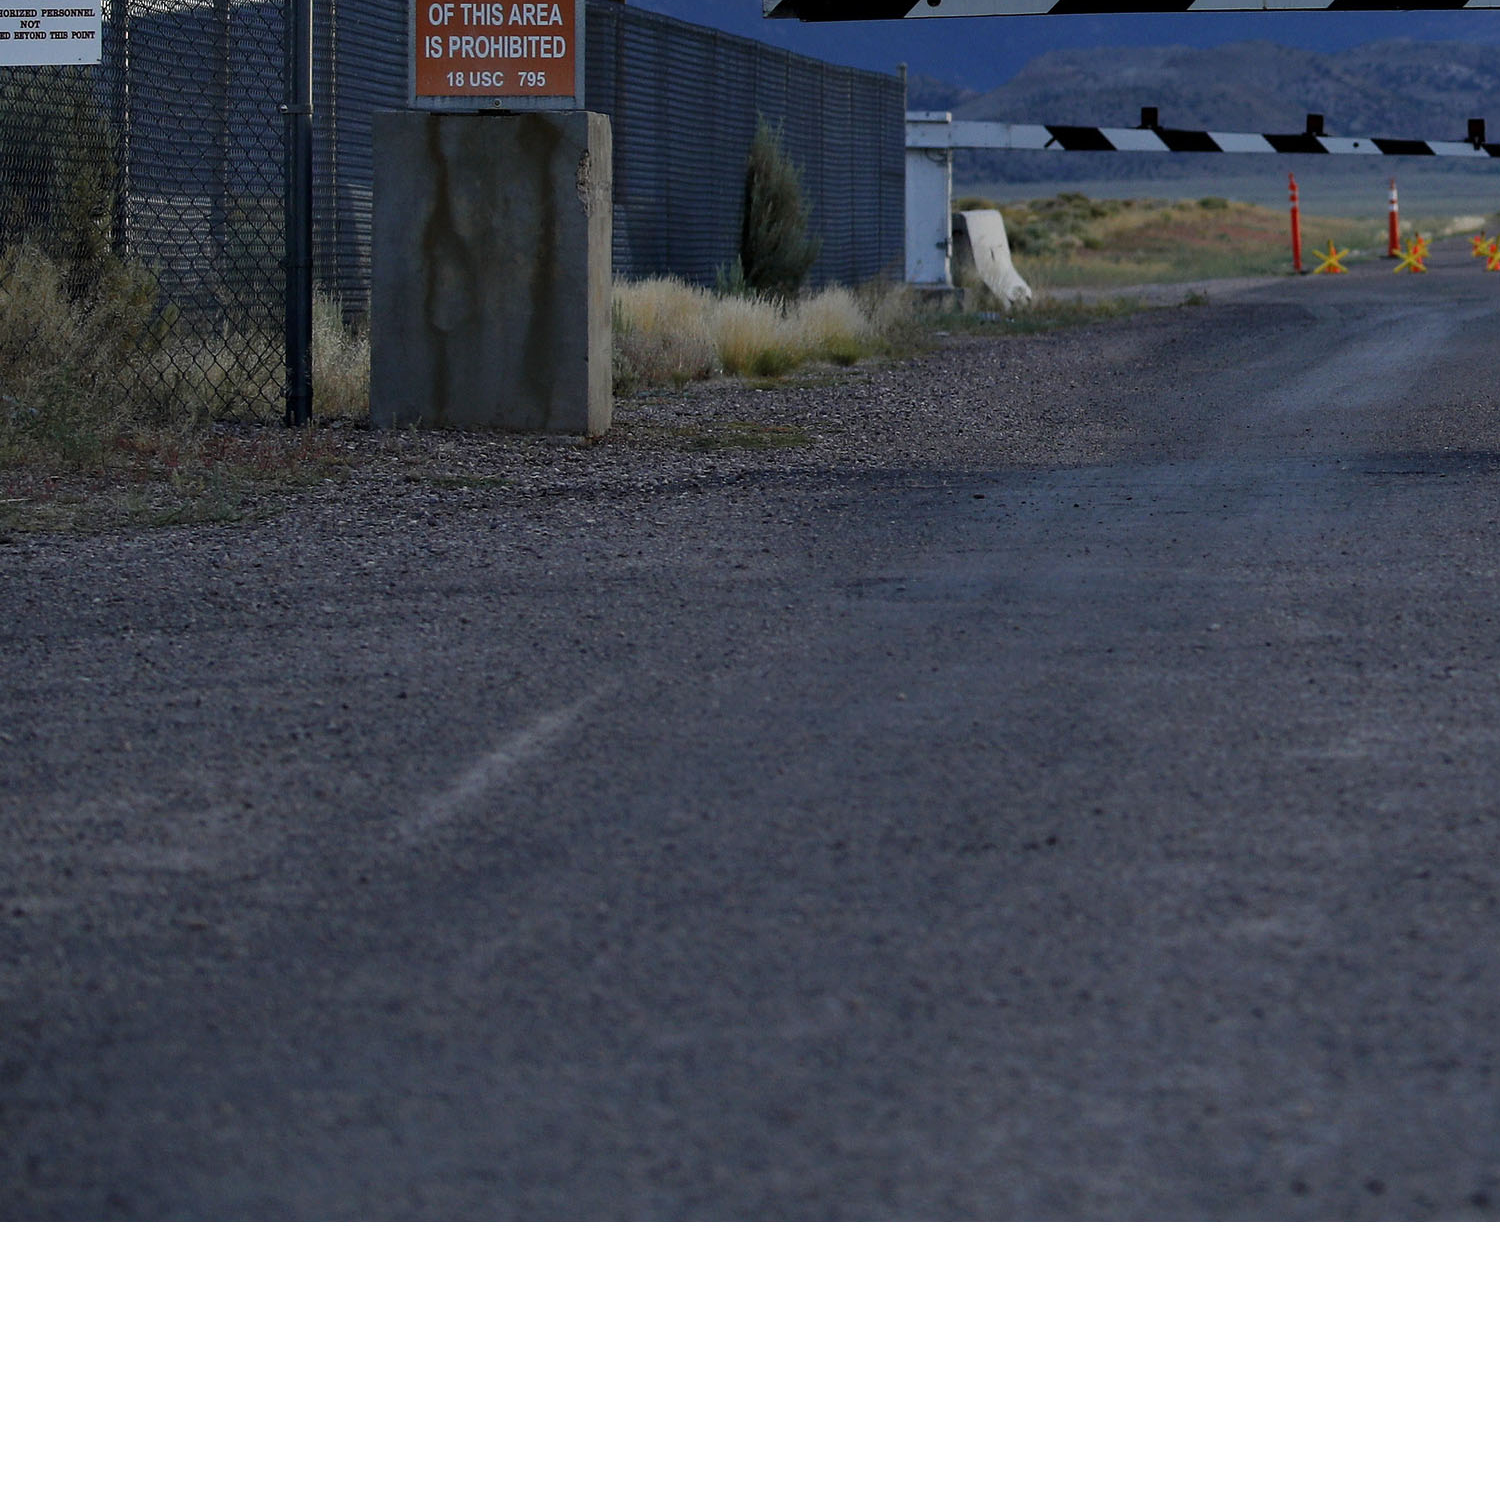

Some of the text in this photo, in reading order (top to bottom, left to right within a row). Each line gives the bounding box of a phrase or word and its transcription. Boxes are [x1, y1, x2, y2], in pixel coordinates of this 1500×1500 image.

[41, 8, 96, 17] PERSONNEL
[428, 3, 563, 26] OF THIS AREA
[20, 20, 41, 29] NOT
[14, 31, 47, 40] BEYOND
[49, 31, 68, 40] THIS
[71, 31, 96, 39] POINT
[425, 35, 566, 59] IS PROHIBITED
[446, 71, 546, 87] 18 USC 795
